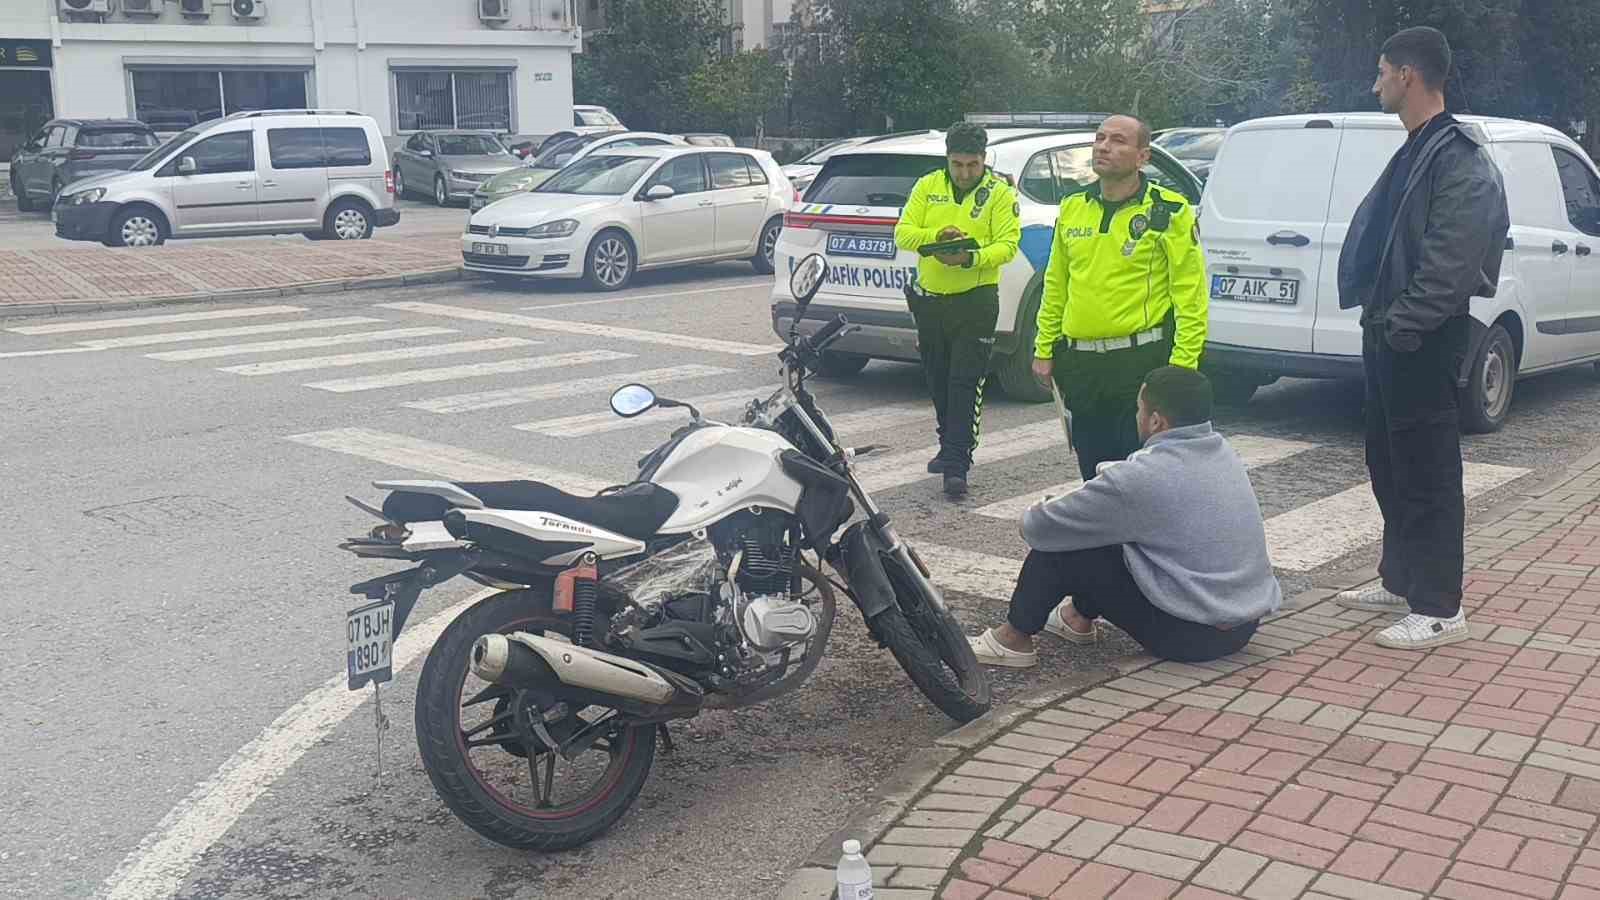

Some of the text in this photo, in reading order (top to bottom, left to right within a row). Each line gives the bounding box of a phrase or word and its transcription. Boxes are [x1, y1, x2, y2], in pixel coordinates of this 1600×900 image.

[832, 238, 892, 253] 07 A 83791
[825, 263, 860, 287] RAFİK
[1220, 278, 1294, 297] 07 AIK 51
[348, 608, 390, 642] 07 BJH
[357, 641, 379, 670] 890
